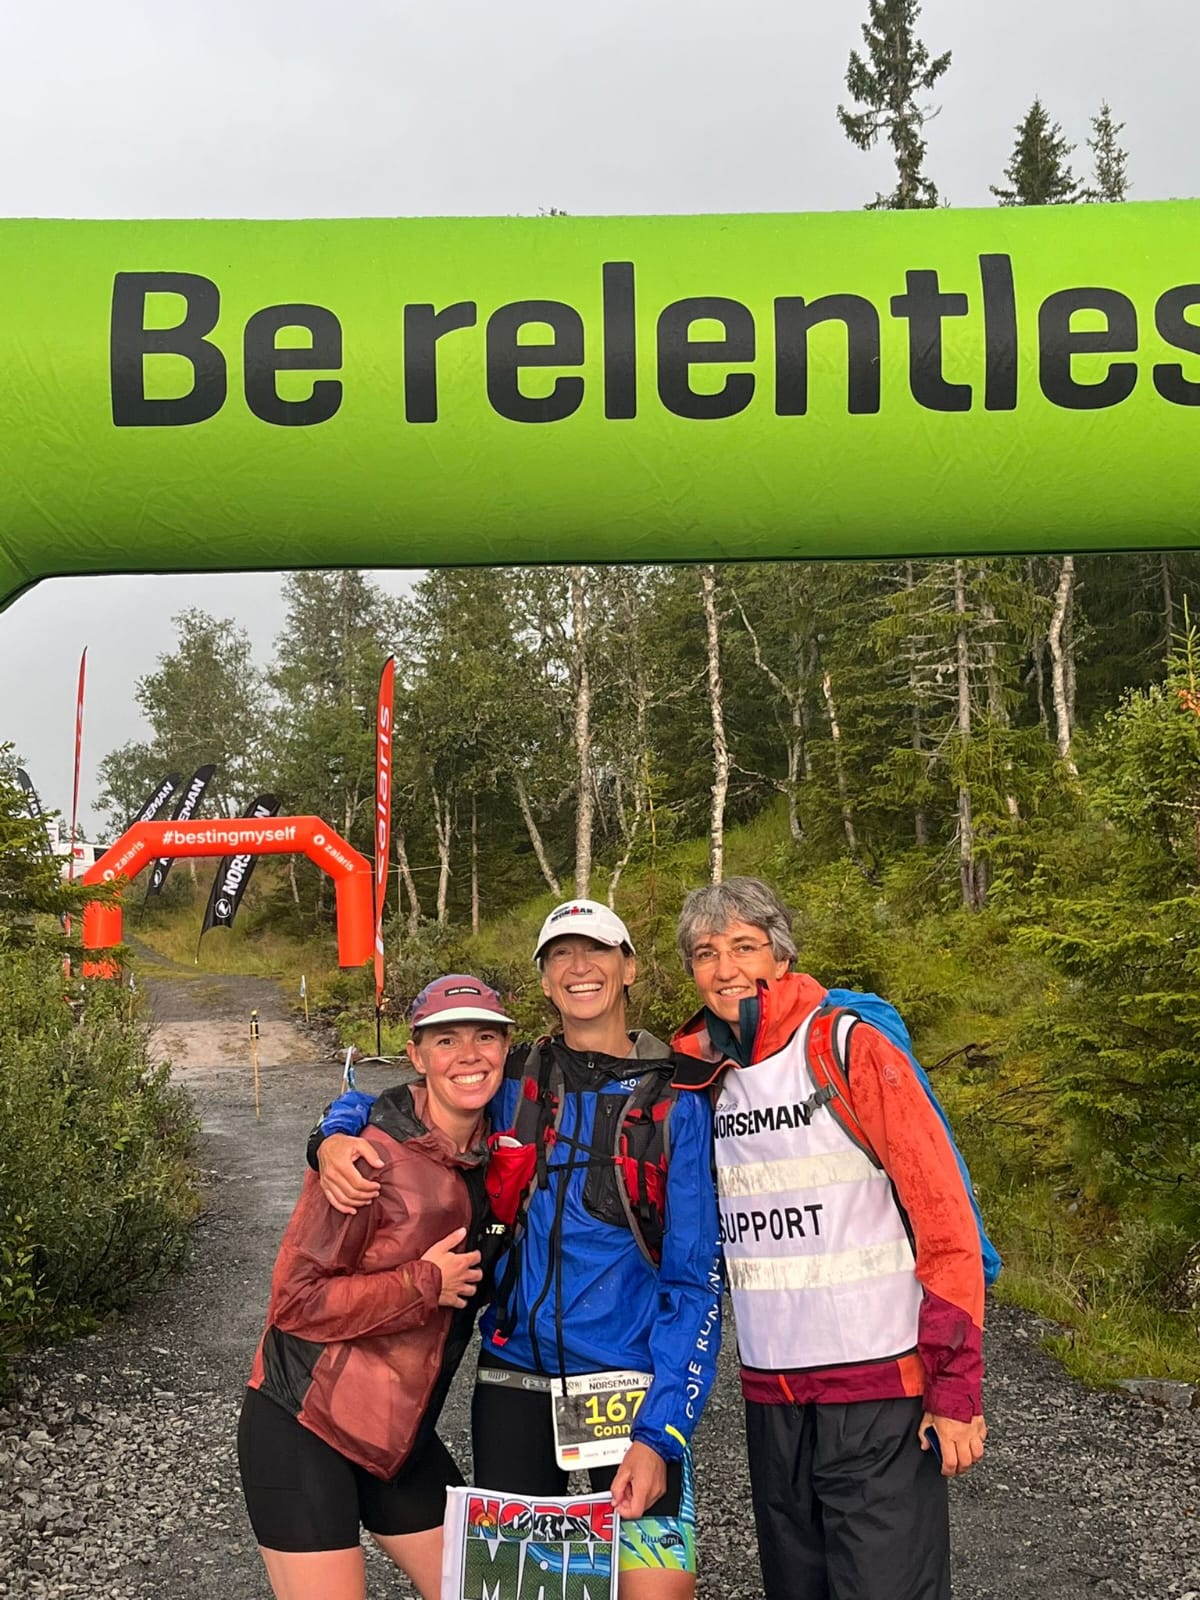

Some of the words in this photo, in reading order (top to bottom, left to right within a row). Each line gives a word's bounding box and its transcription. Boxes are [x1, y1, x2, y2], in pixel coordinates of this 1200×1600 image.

[111, 271, 343, 427] Be
[162, 826, 297, 846] #bestingmyself
[115, 840, 145, 871] zalaris
[324, 843, 354, 872] zalaris
[720, 1204, 823, 1244] SUPPORT
[589, 1377, 640, 1392] NORSEMAN
[585, 1390, 647, 1425] 167
[467, 1497, 614, 1542] NORSE
[641, 1534, 680, 1545] kiwami
[463, 1539, 613, 1600] MAN
